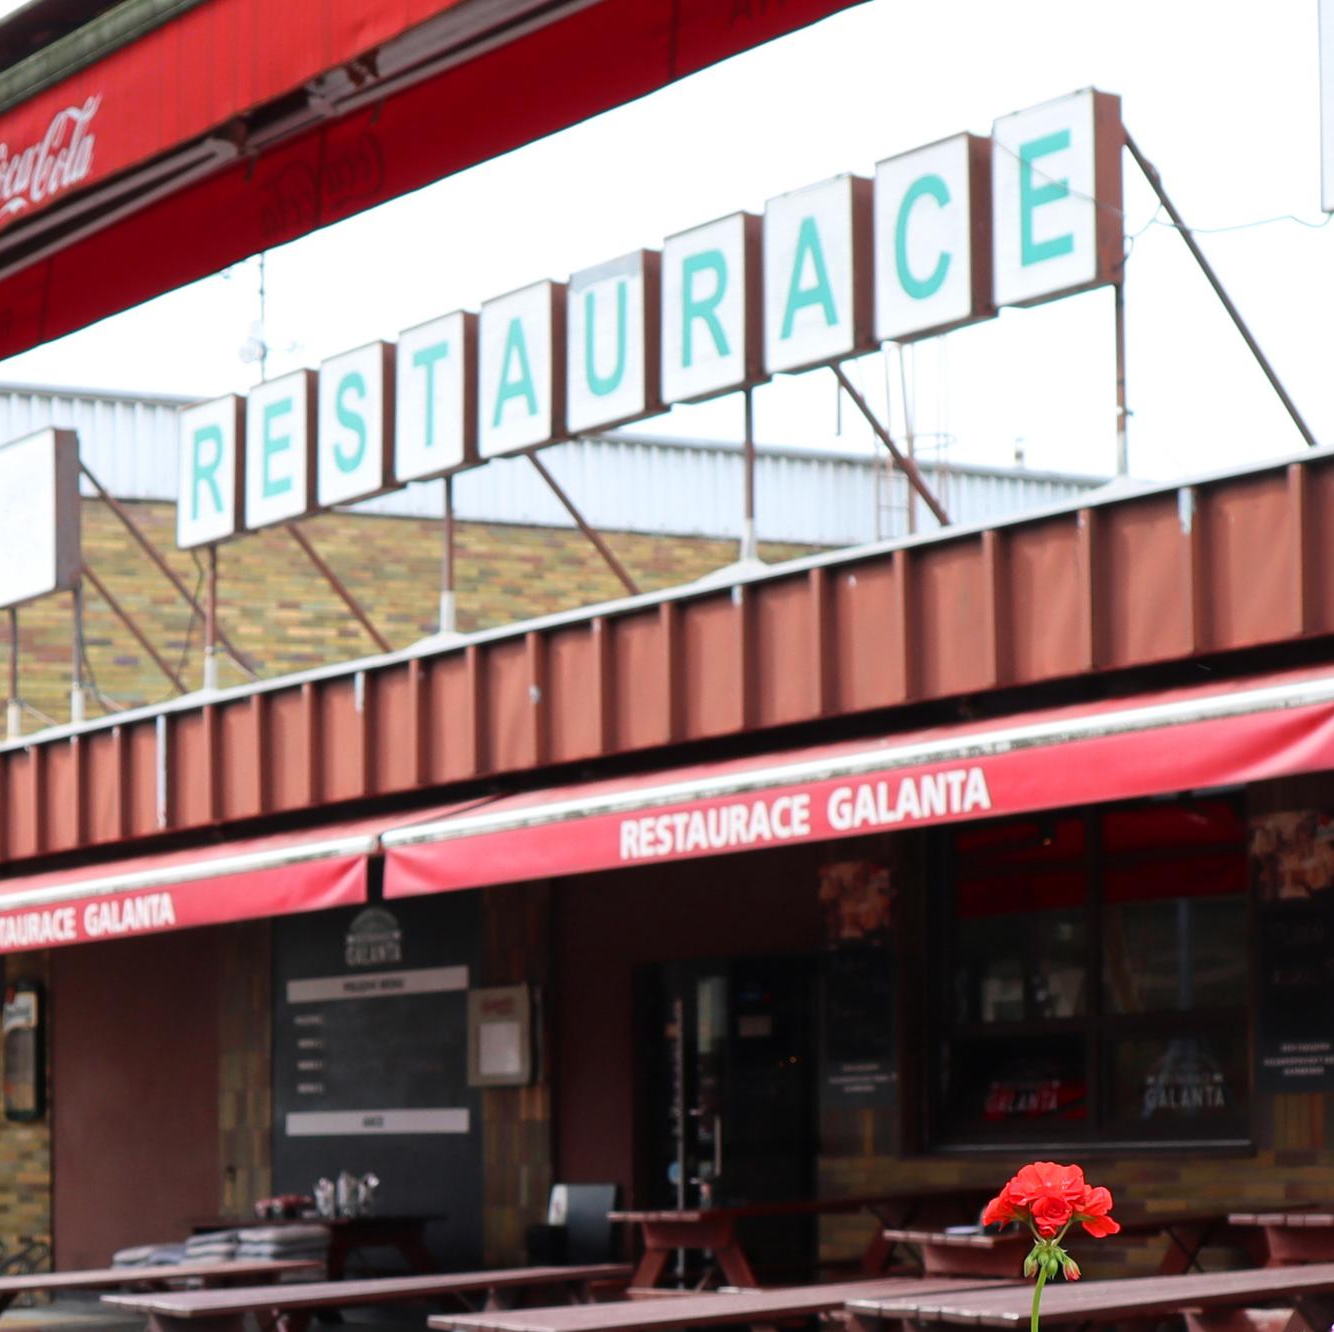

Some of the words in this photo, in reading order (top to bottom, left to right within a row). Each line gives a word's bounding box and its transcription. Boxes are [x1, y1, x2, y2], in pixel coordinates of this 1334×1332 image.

[190, 128, 1074, 521] RESTAURACE
[620, 793, 810, 861] RESTAURACE
[827, 767, 990, 832] GALANTA
[83, 891, 175, 937] GALANTA
